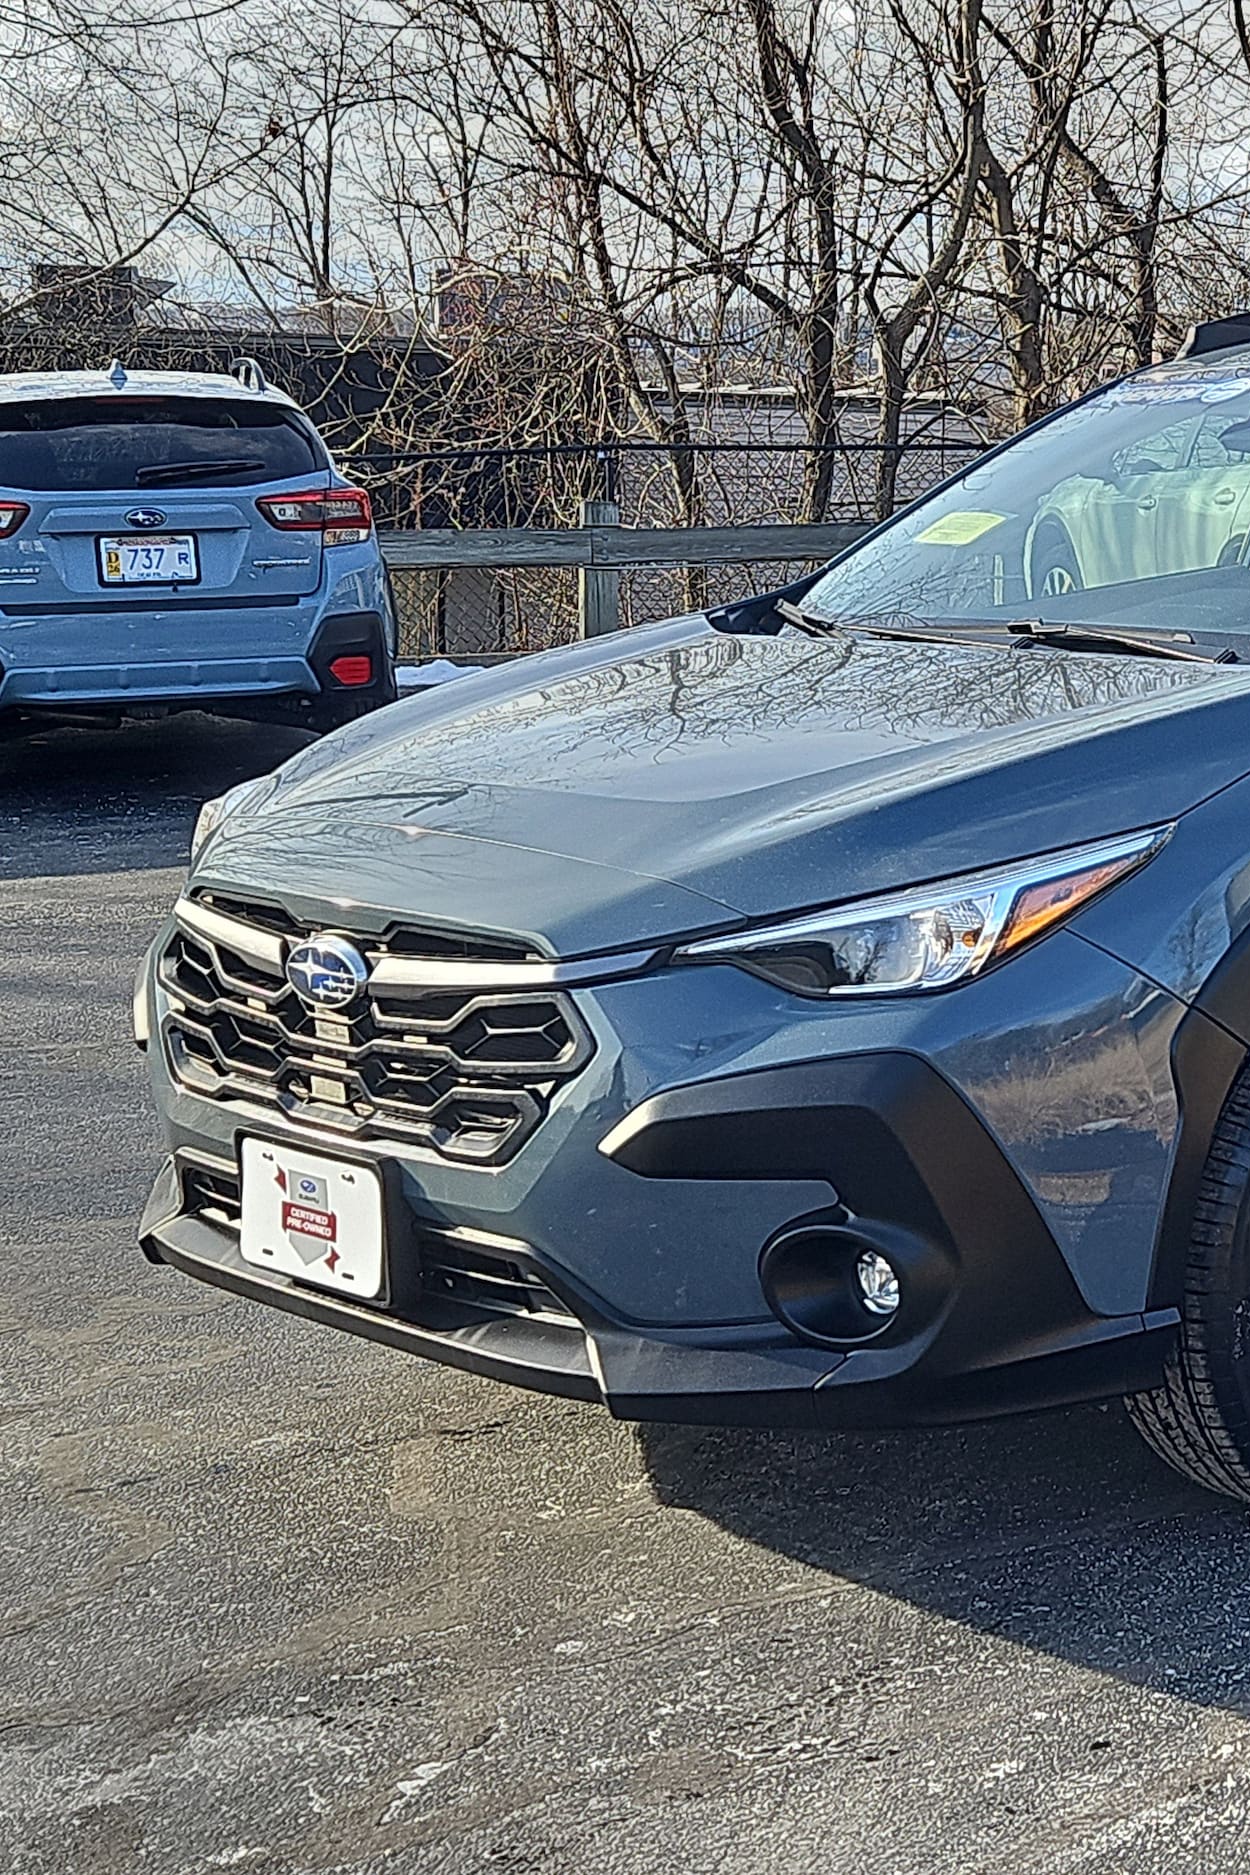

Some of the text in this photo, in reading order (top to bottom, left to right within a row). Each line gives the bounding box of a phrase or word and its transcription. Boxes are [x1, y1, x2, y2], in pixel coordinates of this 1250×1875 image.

[127, 548, 189, 570] 737 R
[286, 1216, 332, 1238] PRE-OWNED
[290, 1207, 329, 1226] CERTIFIED
